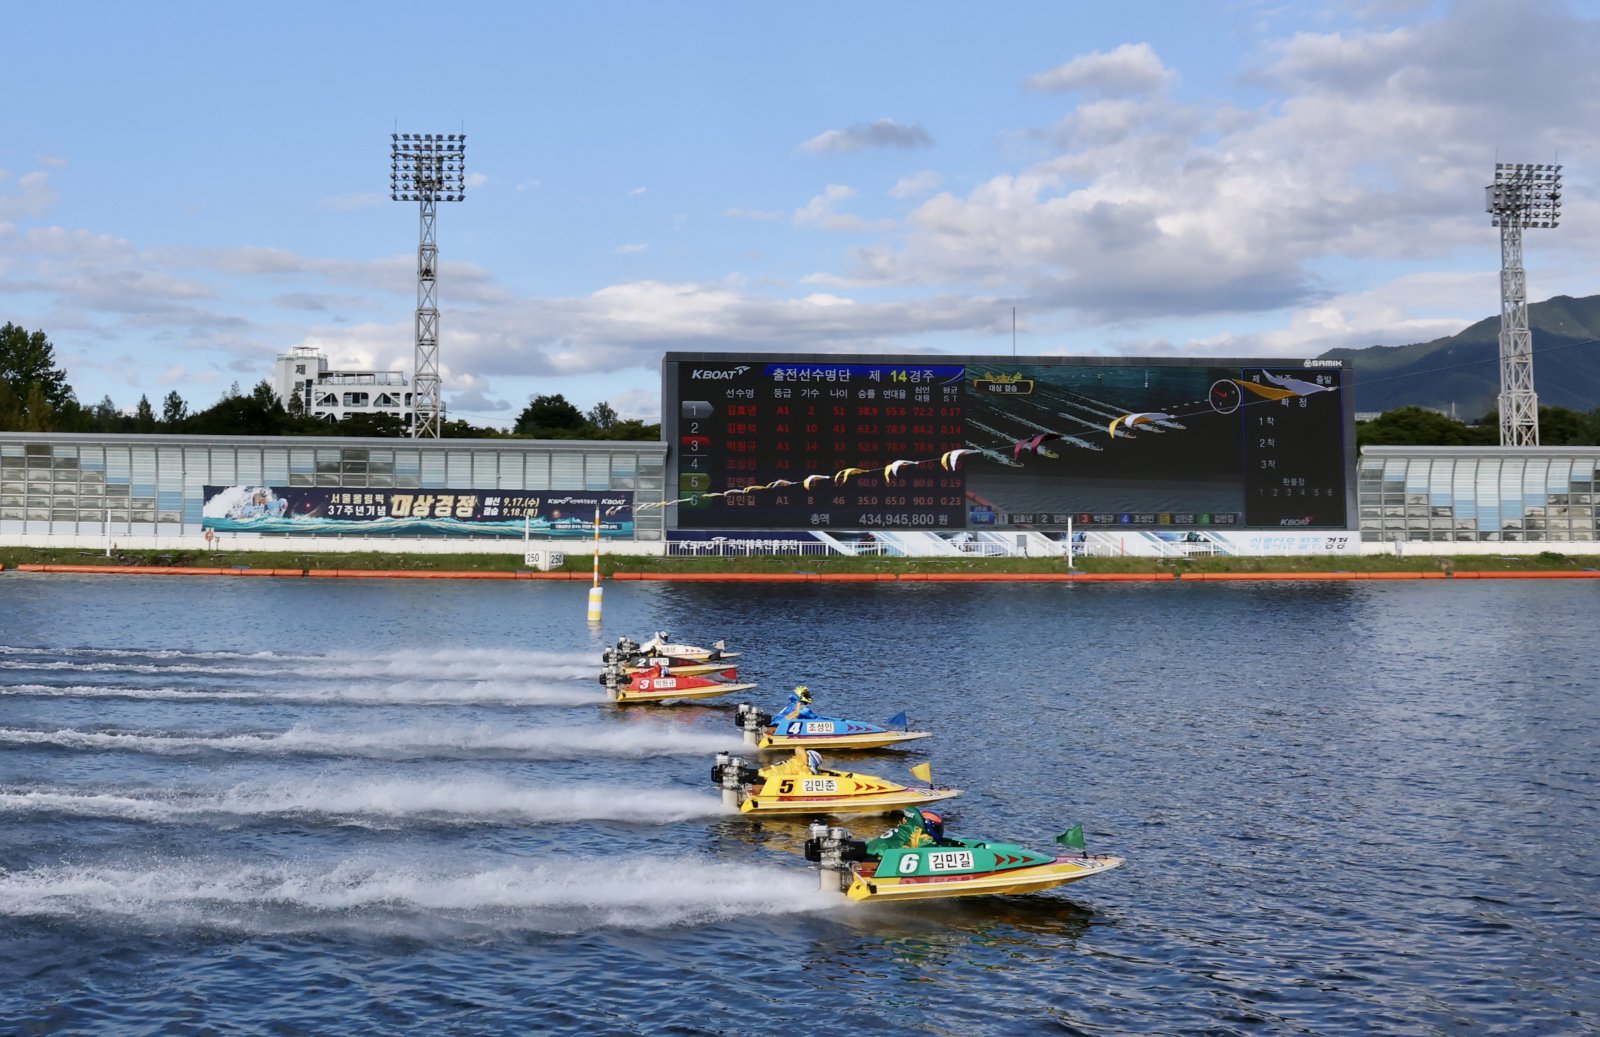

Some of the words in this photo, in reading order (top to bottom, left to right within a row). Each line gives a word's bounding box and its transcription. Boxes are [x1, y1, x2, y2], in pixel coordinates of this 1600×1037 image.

[691, 369, 737, 380] KBOAT
[772, 368, 852, 382] 출전선수명단
[869, 369, 880, 383] 제
[725, 388, 755, 398] 선수명
[773, 388, 792, 398] 등급
[801, 388, 820, 398] 기수
[830, 388, 848, 399] 나이
[857, 389, 876, 399] 승률
[883, 389, 906, 399] 연대율
[943, 386, 958, 394] 평균
[989, 384, 1002, 392] 대상
[692, 405, 697, 416] 1
[776, 406, 790, 415] A1
[941, 406, 961, 416] 0.17
[691, 422, 699, 433] 2
[776, 424, 790, 433] A1
[806, 424, 817, 433] 10
[941, 424, 961, 433] 0.14
[691, 440, 699, 451] 3
[776, 442, 790, 451] A1
[1259, 439, 1275, 448] 2착
[690, 458, 698, 469] 4
[776, 460, 790, 469] A1
[1261, 459, 1276, 469] 3착
[691, 476, 699, 488] 5
[330, 493, 385, 504] 서울올림픽
[690, 494, 698, 506] 6
[726, 496, 756, 507] 김민길
[776, 496, 789, 505] A1
[808, 496, 814, 505] 8
[833, 497, 845, 505] 46
[857, 497, 878, 505] 35.0
[885, 497, 906, 505] 65.0
[913, 497, 934, 505] 90.0
[941, 497, 961, 505] 0.23
[328, 505, 387, 516] 37주년기념
[810, 513, 830, 525] 총액
[859, 514, 935, 526] 434,945,800
[938, 514, 948, 525] 원
[1041, 514, 1048, 523] 2
[1082, 514, 1088, 523] 3
[1121, 514, 1128, 523] 4
[1280, 518, 1310, 526] KBOAT
[679, 540, 715, 550] KSPO
[1325, 537, 1348, 550] 경정
[526, 553, 540, 563] 250
[551, 554, 563, 564] 250
[636, 658, 647, 667] 2
[639, 679, 650, 689] 3
[788, 722, 801, 734] 4
[809, 723, 833, 732] 조성인
[779, 779, 794, 793] 5
[804, 779, 835, 791] 김민준
[899, 853, 920, 873] 6
[932, 852, 971, 869] 김민길
